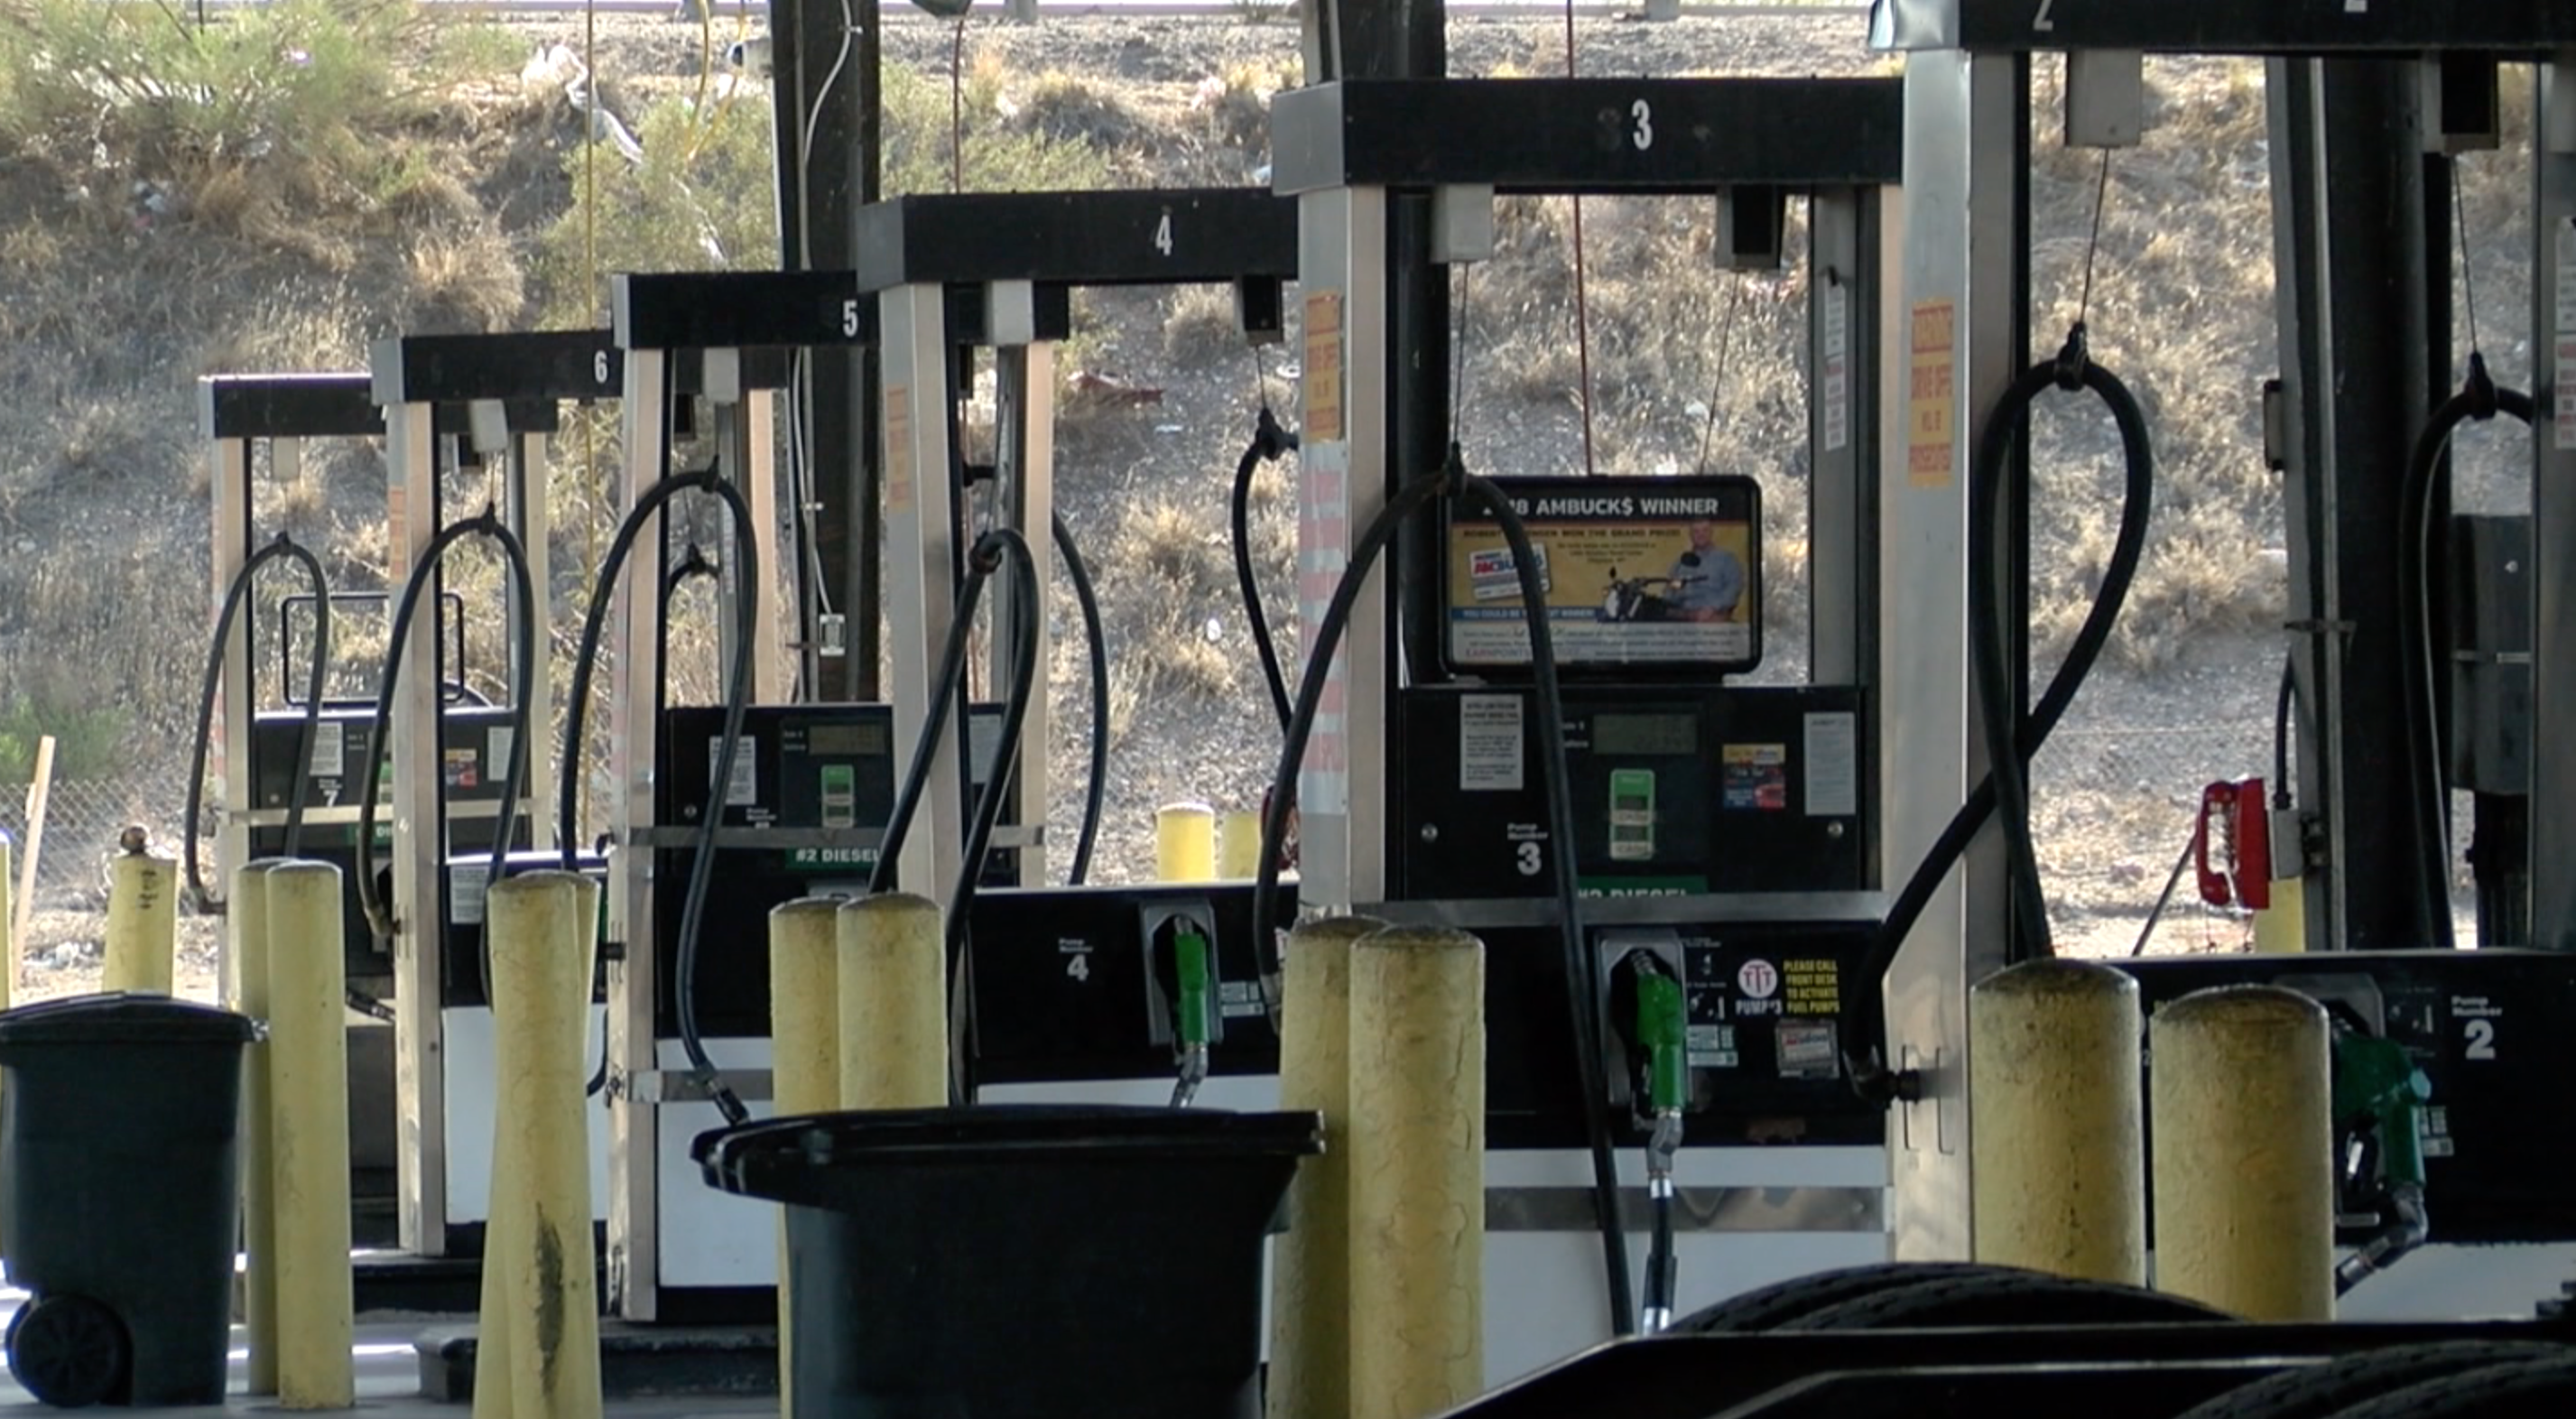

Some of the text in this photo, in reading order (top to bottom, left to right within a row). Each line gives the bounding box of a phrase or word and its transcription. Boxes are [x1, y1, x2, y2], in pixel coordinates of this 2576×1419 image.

[1631, 98, 1654, 151] 3
[1155, 214, 1173, 256] 4
[842, 299, 859, 338] 5
[594, 349, 609, 384] 6
[1535, 496, 1634, 517] AMBUCK$
[1639, 497, 1719, 516] WINNER
[323, 789, 339, 807] 7
[795, 849, 818, 863] #2
[1516, 841, 1543, 876] 3
[1066, 953, 1089, 981] 4
[1784, 960, 1814, 973] PLEASE
[2464, 1018, 2497, 1061] 2
